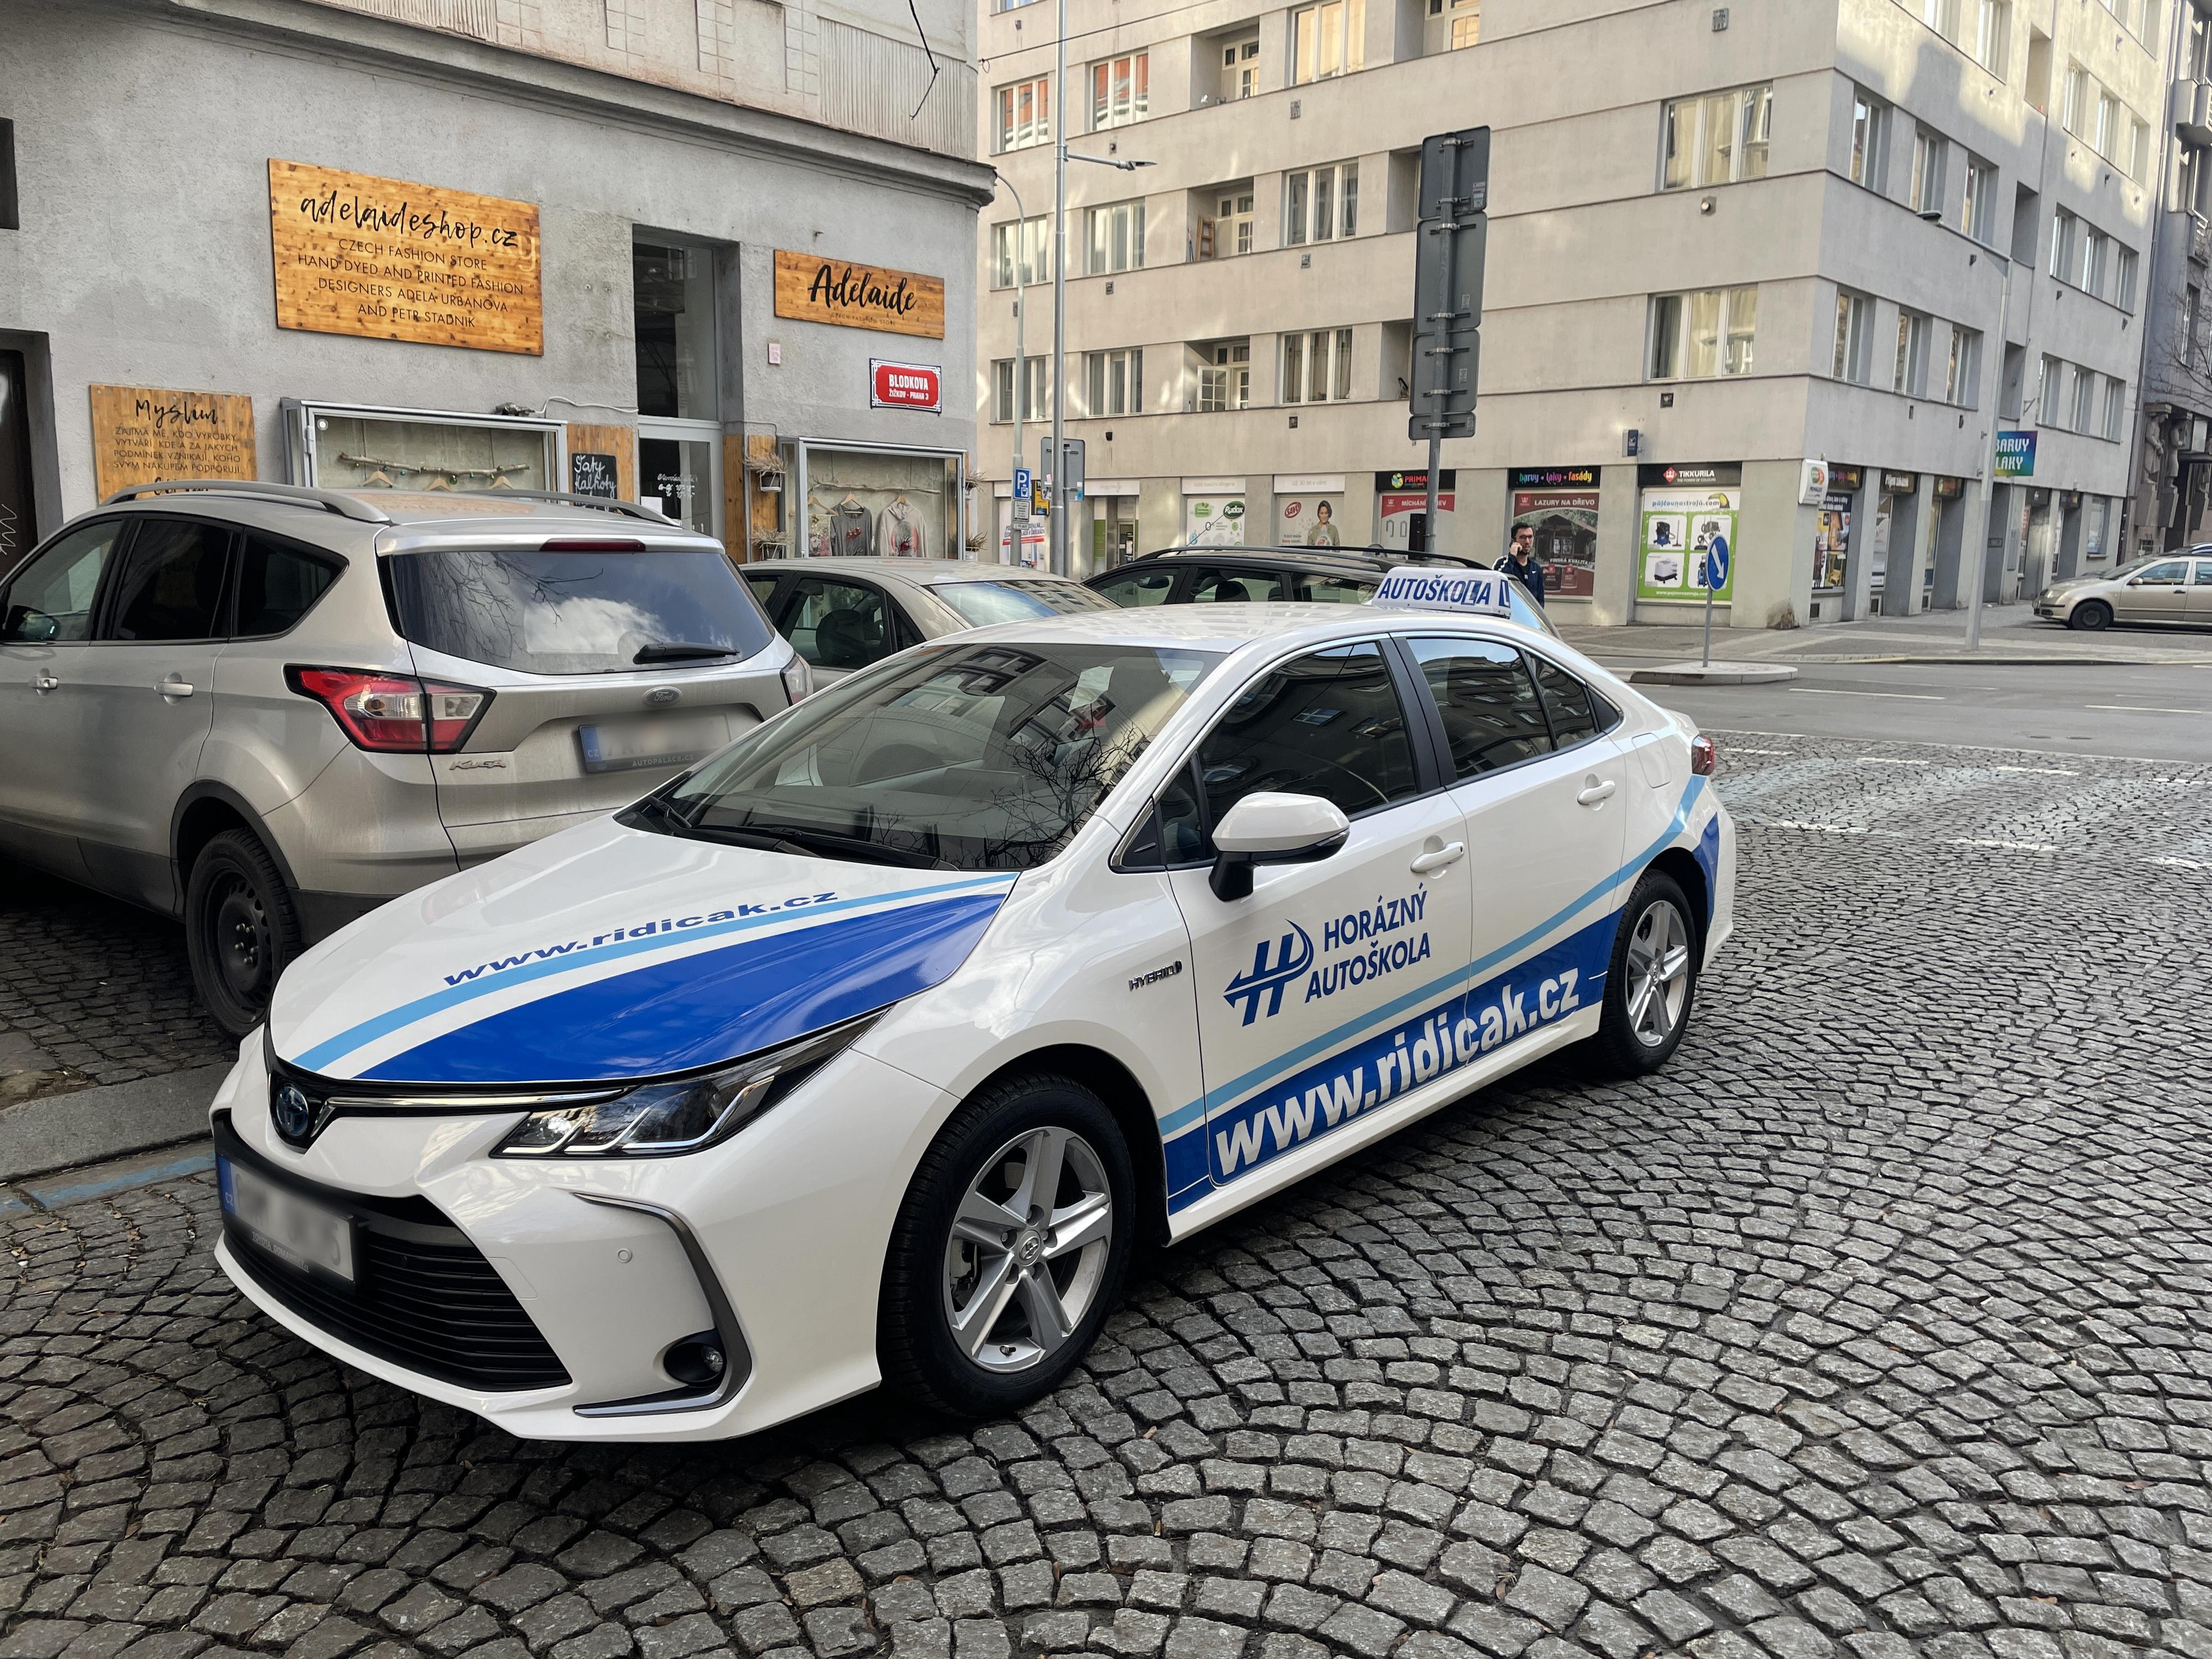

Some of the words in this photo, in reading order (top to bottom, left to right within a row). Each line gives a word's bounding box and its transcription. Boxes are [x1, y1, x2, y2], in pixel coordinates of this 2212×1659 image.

[300, 190, 519, 248] adelaideshop.cz
[338, 238, 383, 255] CZECH
[389, 246, 445, 264] FASHION
[450, 254, 488, 271] STORE
[298, 254, 338, 270] HAND
[345, 260, 378, 275] DYED
[384, 265, 412, 279] AND
[418, 270, 466, 288] PRINTED
[471, 278, 523, 295] FASHION
[319, 278, 392, 298] DESIGNERS
[398, 288, 436, 302] ADELA
[441, 294, 508, 313] URBANOVA
[807, 264, 917, 315] Adelaide
[358, 304, 387, 317] AND
[393, 307, 419, 321] PETR
[425, 312, 475, 327] STADNIK
[889, 374, 928, 390] BLODKOVA
[889, 388, 906, 398] ŽIŽKOV
[910, 392, 925, 400] PRAHA
[173, 430, 192, 439] KDO
[213, 454, 241, 462] KOHO
[1995, 456, 2023, 470] LAKY
[1018, 472, 1027, 489] P
[1519, 472, 1539, 484] barvy
[1546, 472, 1561, 483] laky
[1568, 470, 1593, 484] fasády
[1678, 469, 1715, 478] TIKKURILA
[1572, 497, 1595, 505] DŘEVO
[1378, 575, 1492, 606] AUTOŠKOLA
[654, 691, 674, 702] Ford
[587, 749, 599, 758] CZ
[632, 754, 695, 768] AUTOPALACE.CZ
[449, 760, 507, 770] KUGA
[1324, 882, 1428, 952] HORÁZNÝ
[443, 891, 839, 986] www.ridicak.cz
[1305, 932, 1431, 1004] AUTOŠKOLA
[1128, 965, 1174, 992] HYBRID
[1216, 967, 1580, 1177] www.ridicak.cz
[225, 1192, 234, 1207] CZ
[252, 1231, 272, 1252] TOYOTA
